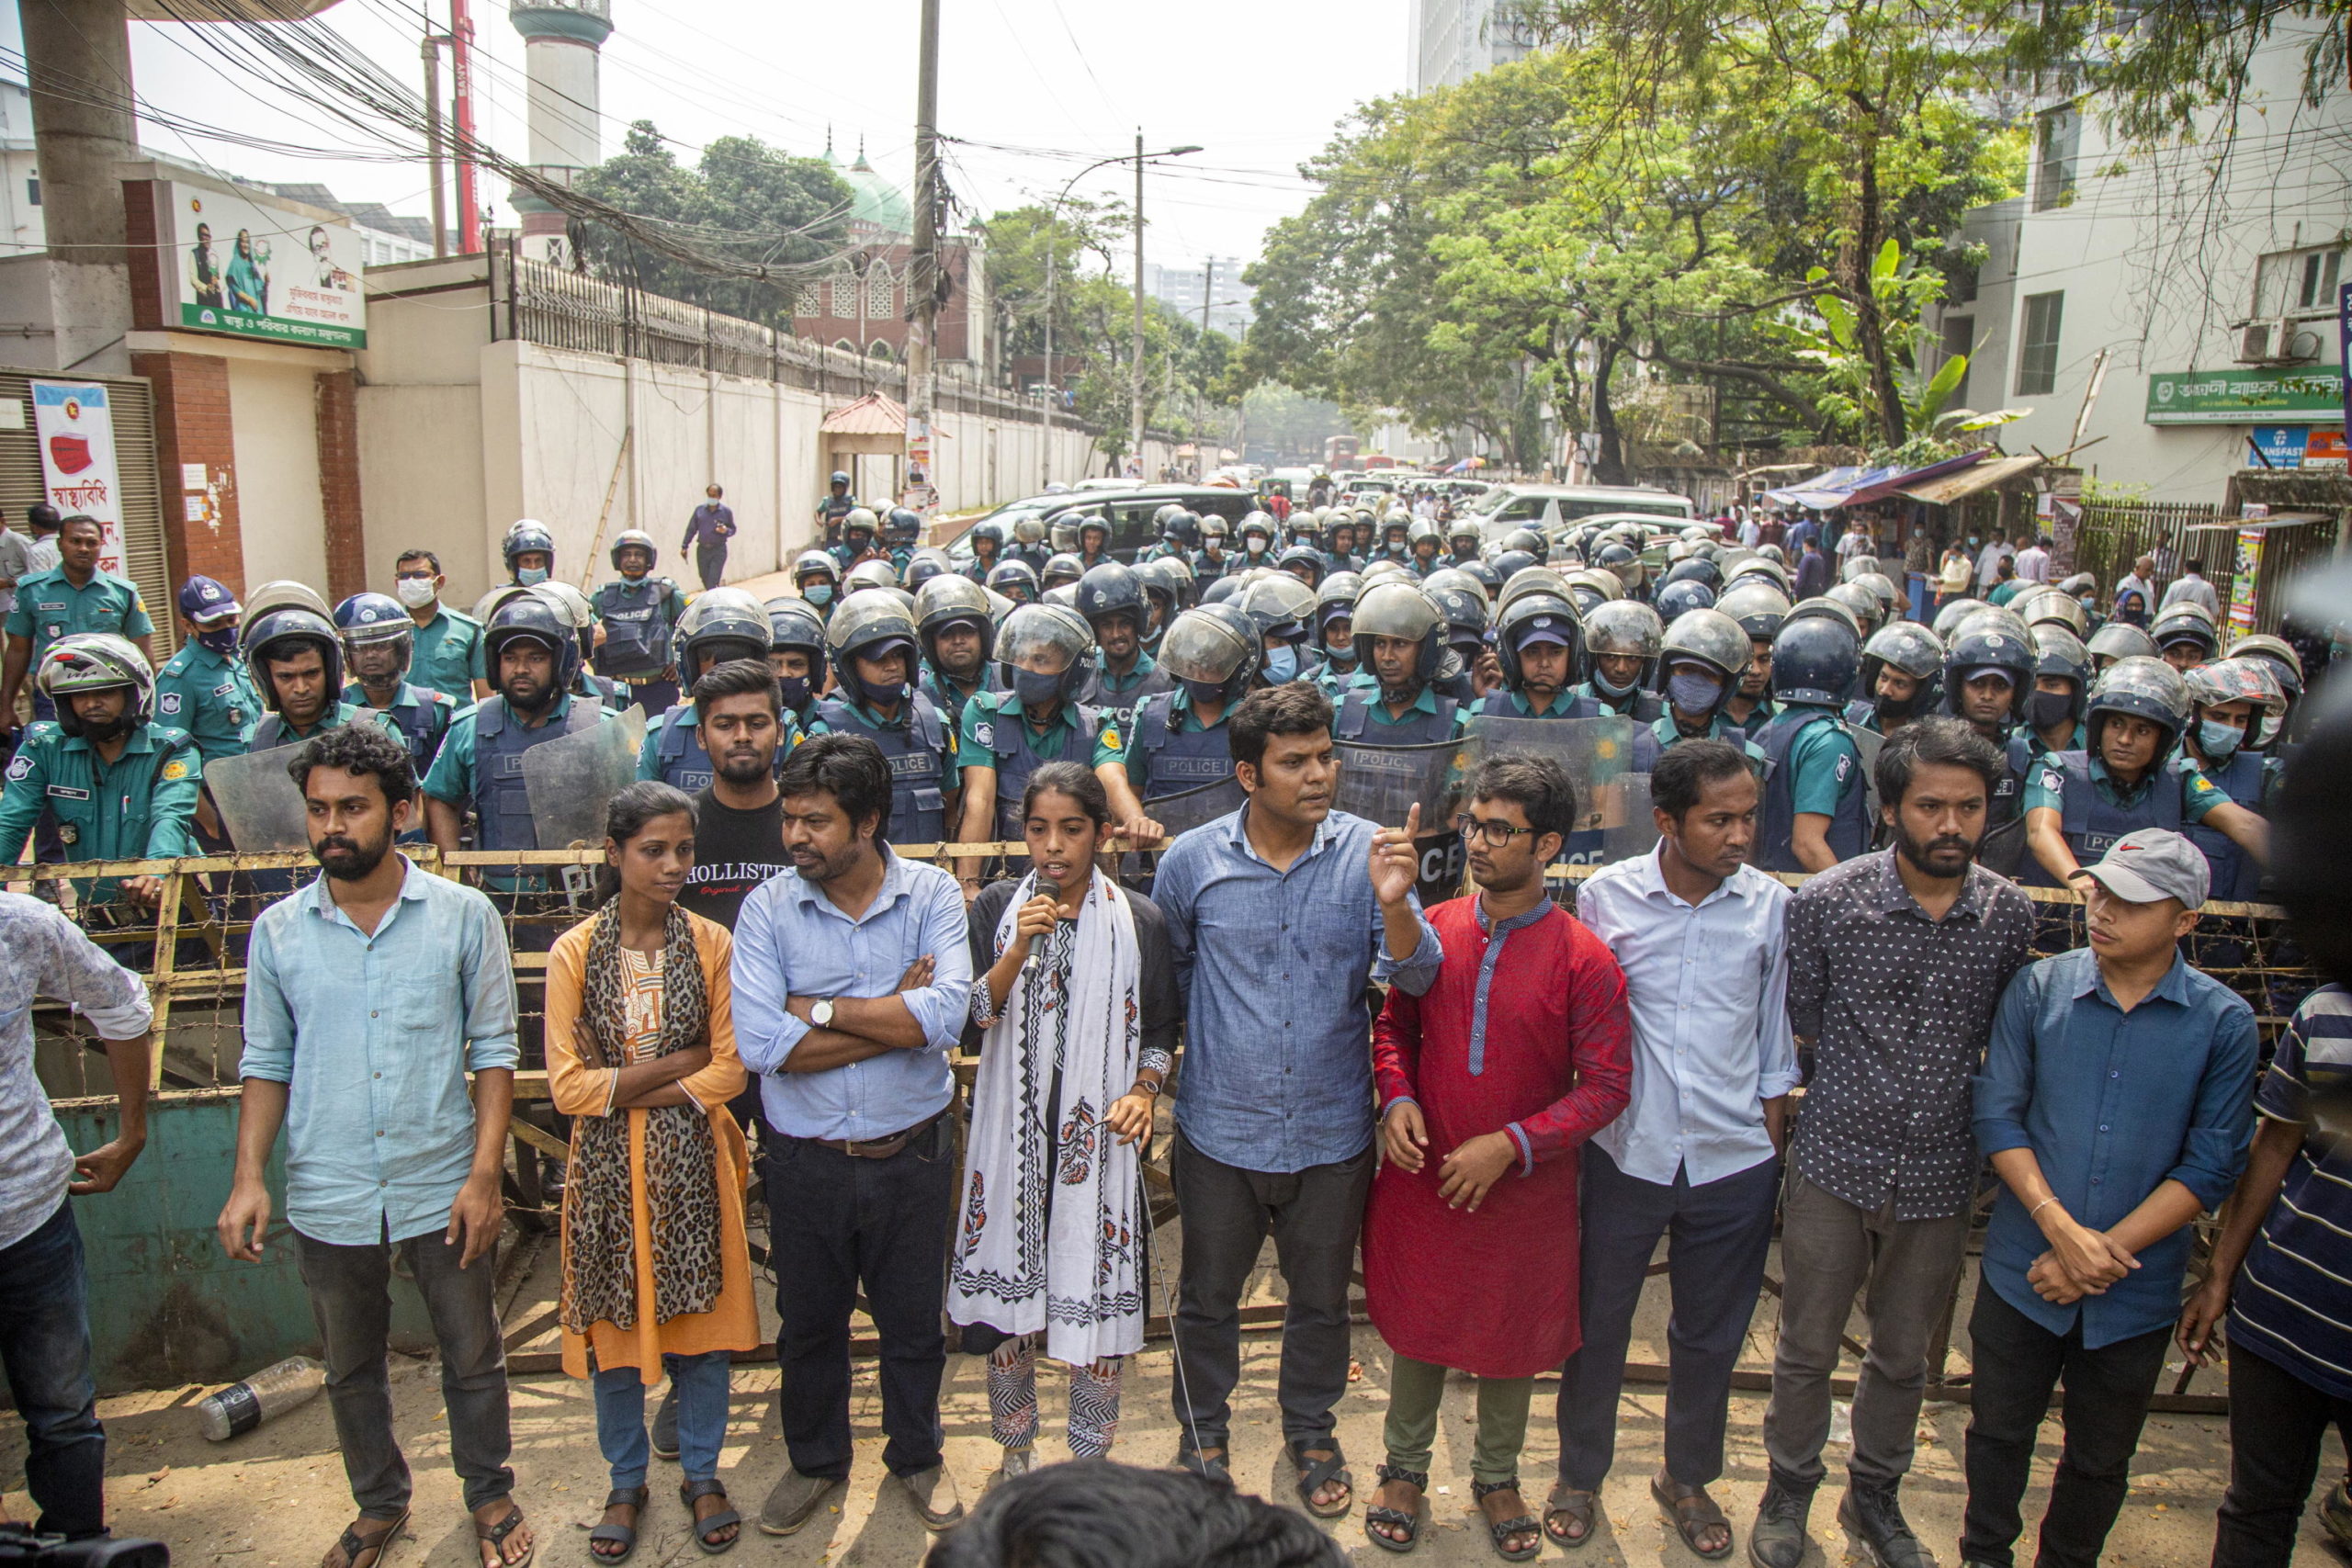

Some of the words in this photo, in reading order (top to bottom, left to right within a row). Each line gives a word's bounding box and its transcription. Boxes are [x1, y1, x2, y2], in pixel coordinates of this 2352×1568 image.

[222, 314, 244, 330] স্বাস্থ্য
[247, 318, 254, 328] ও
[256, 319, 289, 333] পরিবার
[291, 326, 316, 337] কল্যাণ
[2254, 446, 2304, 457] ANSFAST
[51, 479, 107, 512] স্বাস্থ্যবিধি
[888, 758, 926, 772] OLICE
[1169, 761, 1221, 773] POLICE
[686, 863, 797, 884] HOLLISTE
